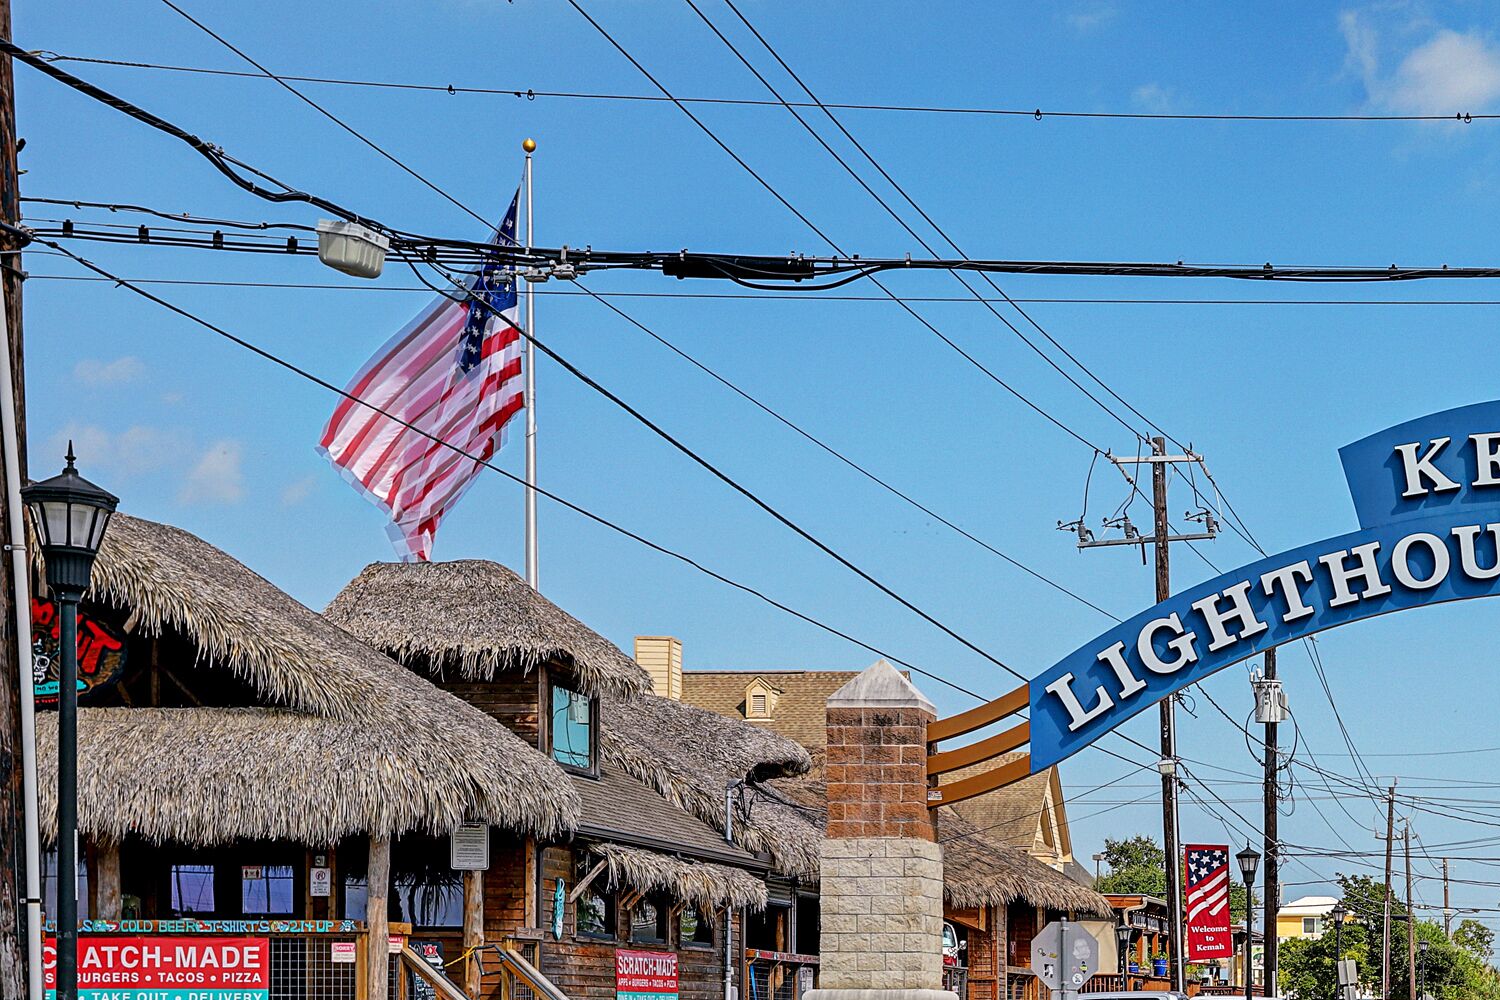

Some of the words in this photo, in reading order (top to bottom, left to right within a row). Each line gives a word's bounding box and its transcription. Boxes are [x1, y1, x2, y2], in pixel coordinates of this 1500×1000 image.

[120, 921, 153, 933] COLD
[212, 921, 270, 933] T-SHIRTS
[1191, 925, 1228, 933] Welcome
[1196, 943, 1225, 952] Kemah
[43, 945, 261, 968] CATCH-MADE
[618, 956, 677, 977] SCRATCH-MADE
[77, 972, 139, 983] BURGERS
[158, 972, 205, 983] TACOS
[222, 973, 262, 983] PIZZA
